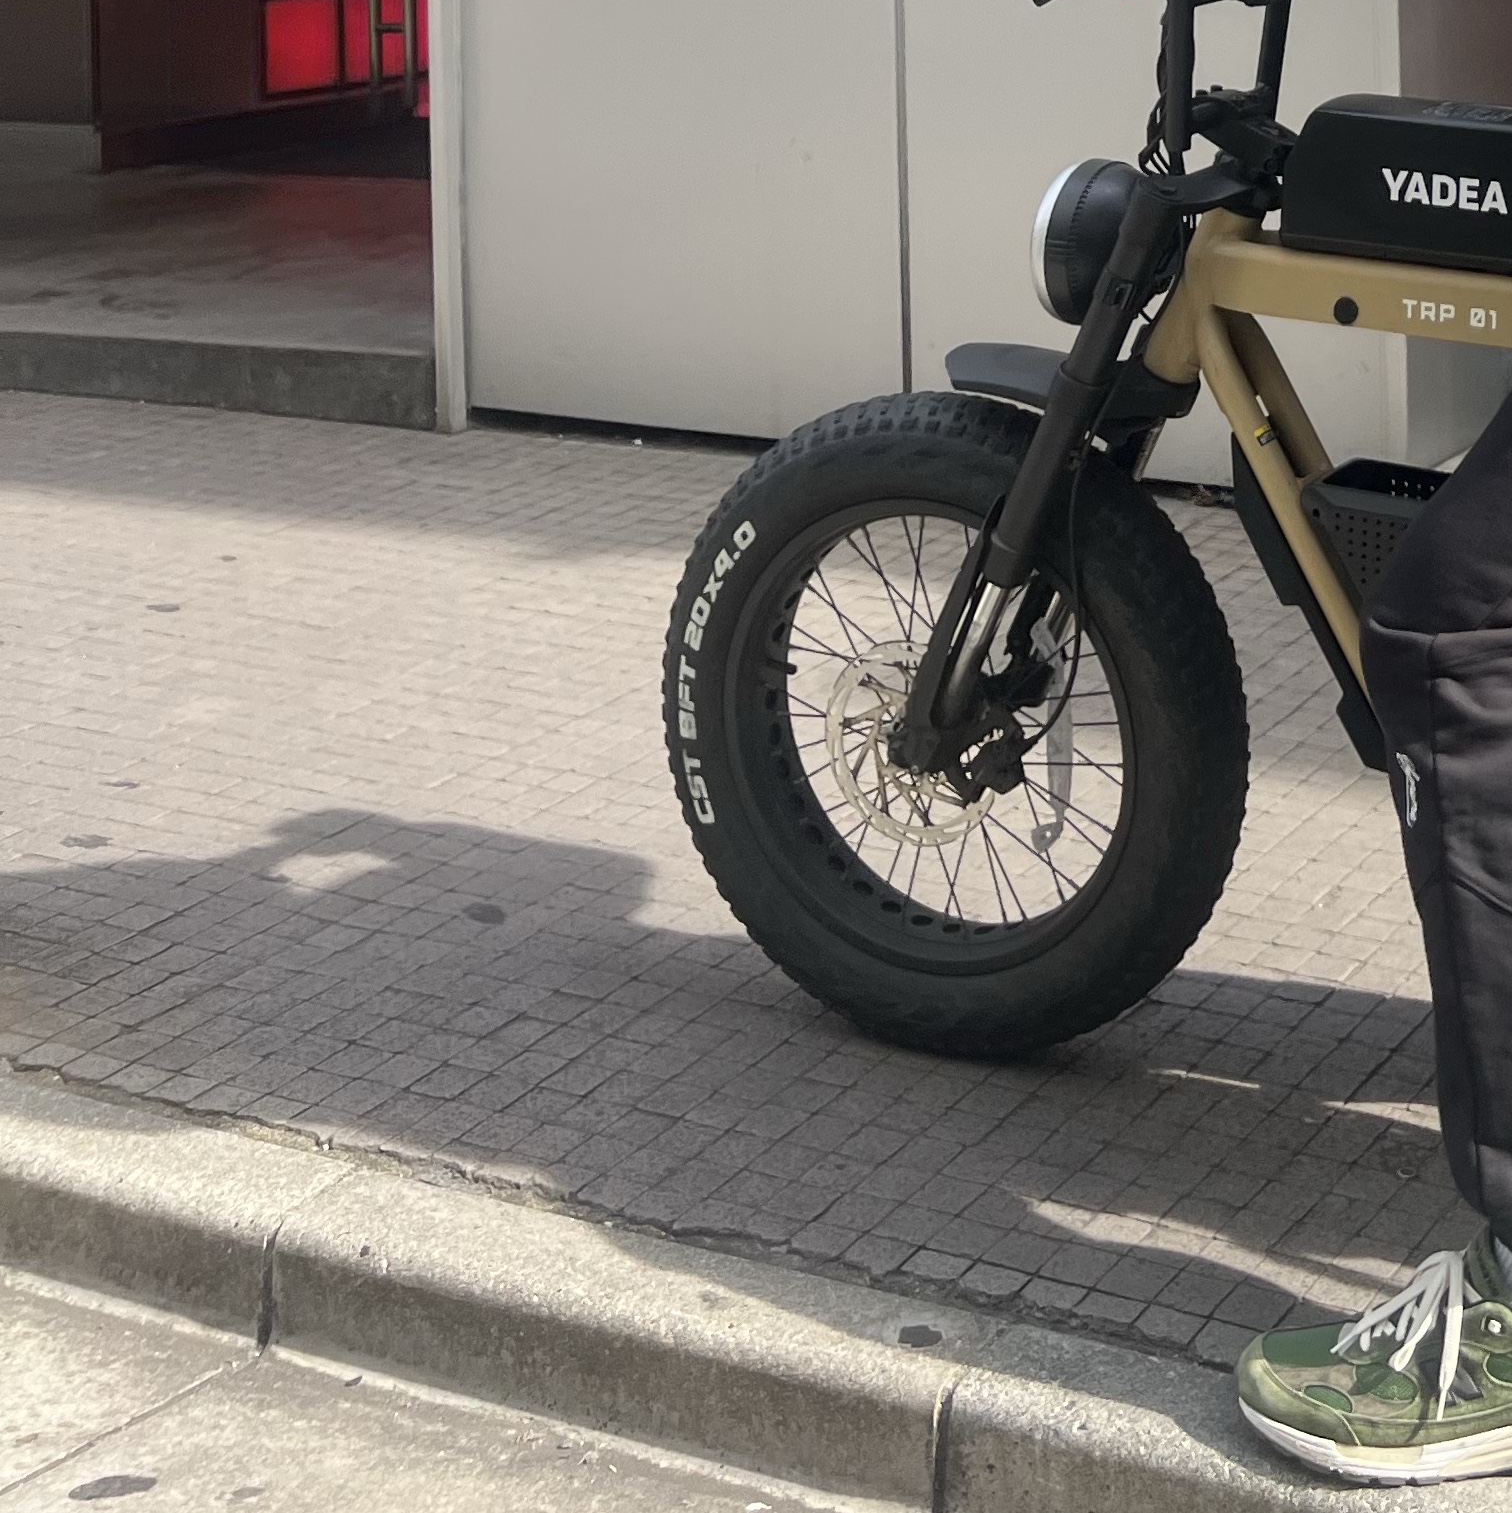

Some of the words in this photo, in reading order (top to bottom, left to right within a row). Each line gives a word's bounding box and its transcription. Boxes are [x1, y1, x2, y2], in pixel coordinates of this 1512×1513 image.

[1382, 167, 1508, 215] YADEA
[1402, 298, 1456, 323] TRP
[1469, 307, 1497, 329] 01
[678, 654, 698, 740] BFT
[682, 748, 716, 825] CST
